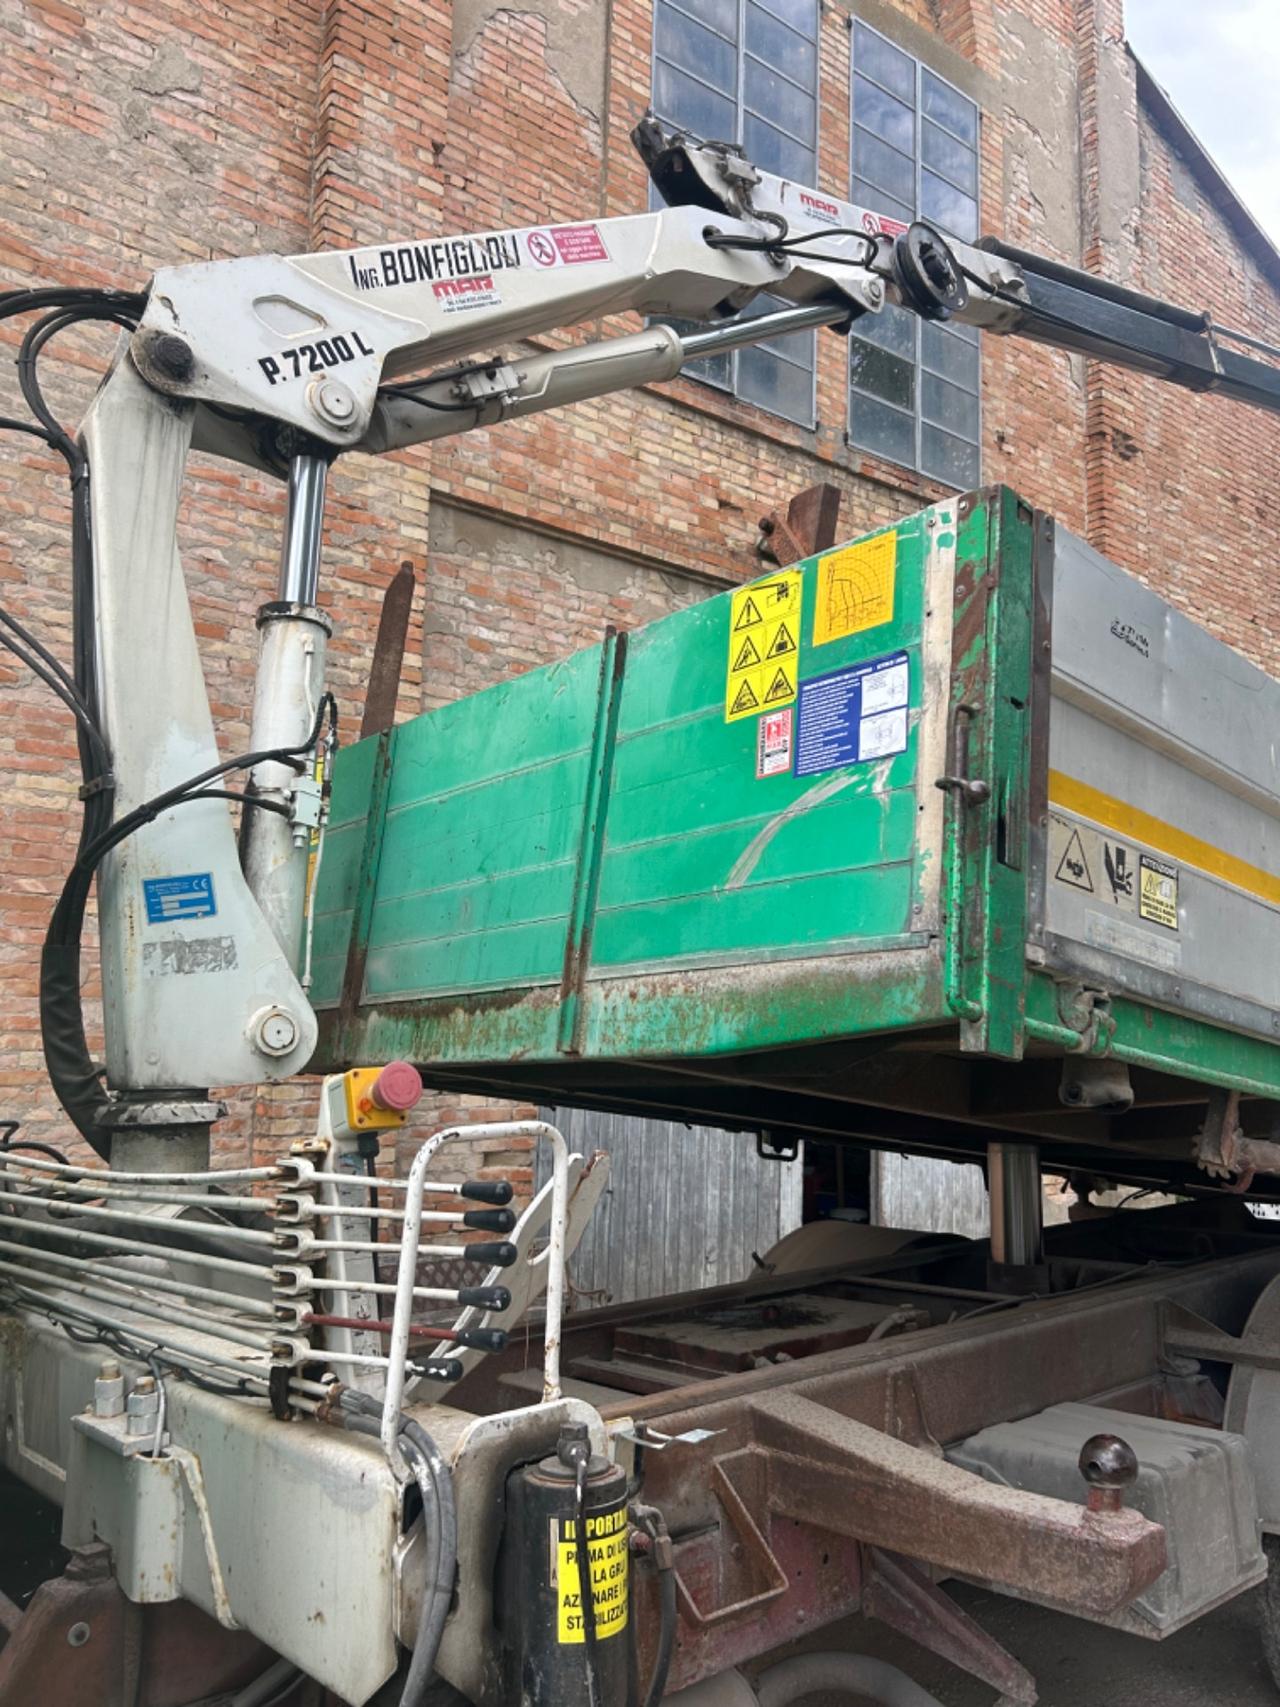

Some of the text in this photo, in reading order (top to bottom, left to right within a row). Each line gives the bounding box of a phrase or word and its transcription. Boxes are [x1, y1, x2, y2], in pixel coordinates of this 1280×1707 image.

[380, 234, 521, 286] BONFIGLIOLI
[350, 331, 375, 356] L
[566, 1547, 605, 1565] PMA
[593, 1568, 607, 1584] LA
[563, 1585, 618, 1608] AZNARE
